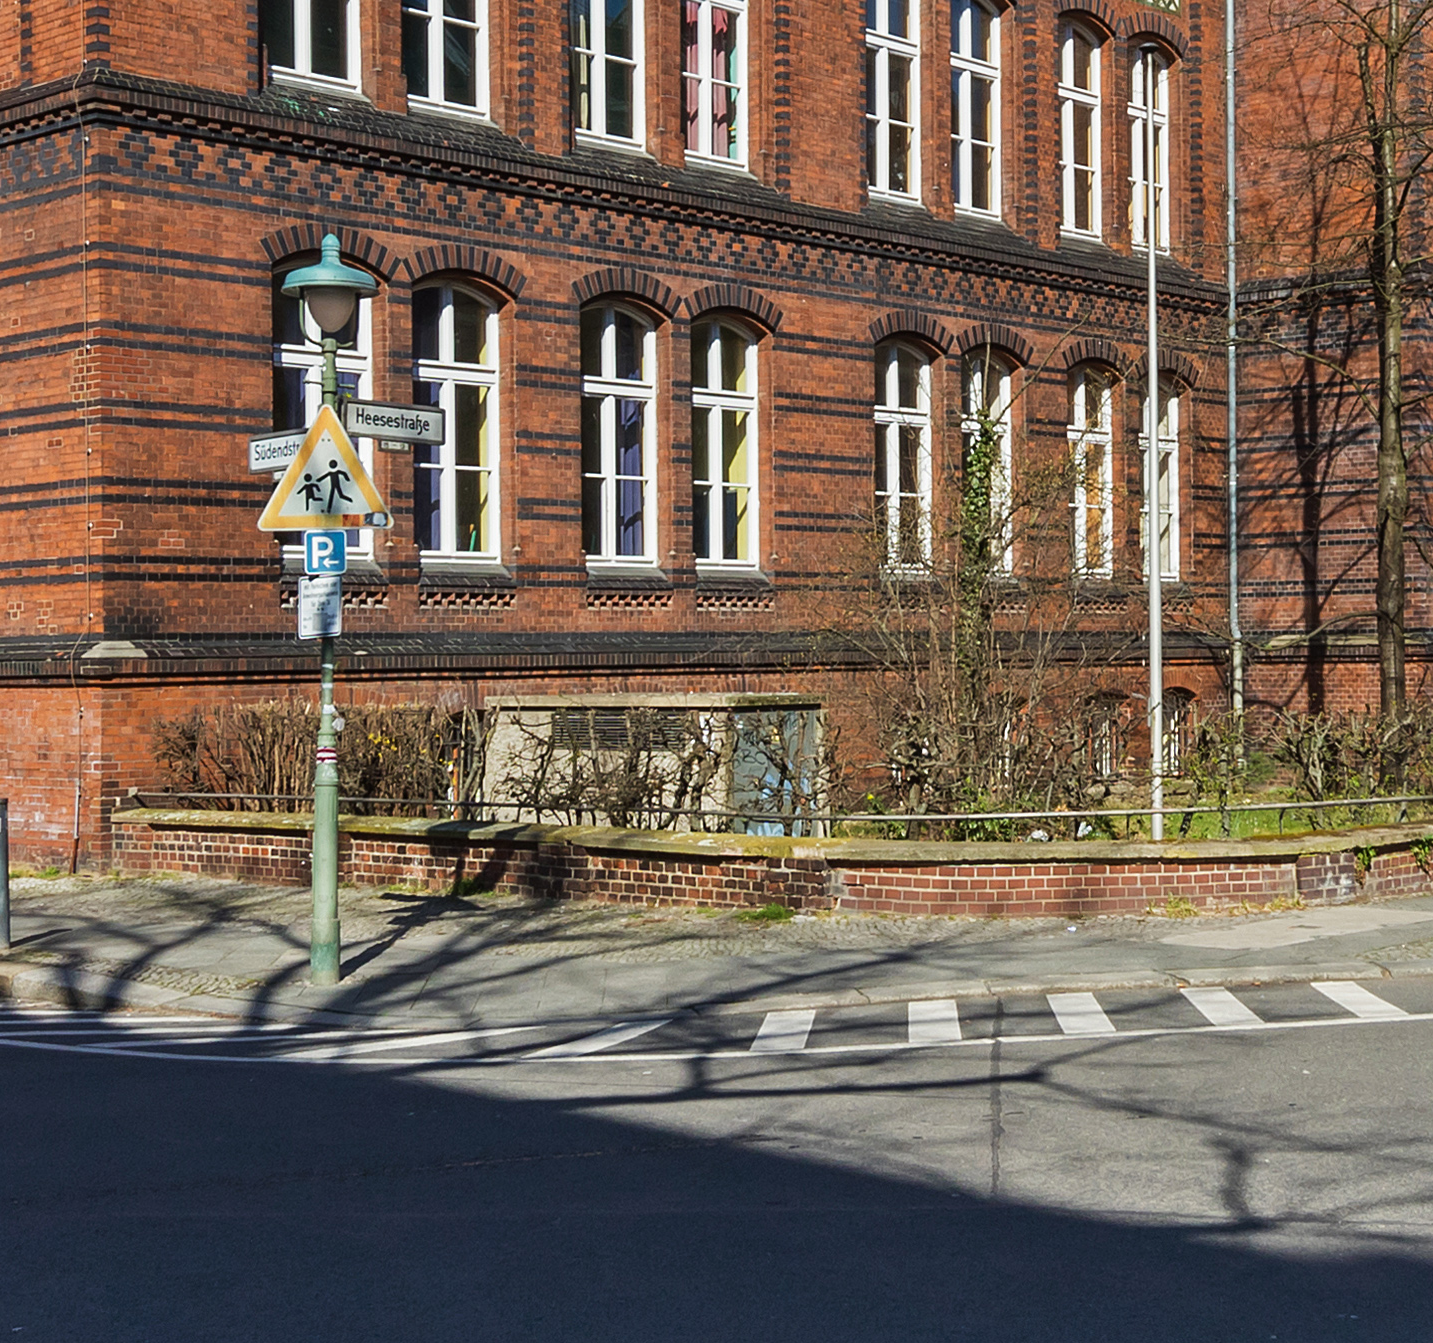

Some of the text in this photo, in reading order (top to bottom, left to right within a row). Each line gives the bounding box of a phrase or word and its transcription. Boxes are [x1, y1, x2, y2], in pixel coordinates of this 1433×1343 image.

[355, 407, 430, 436] Heesestraße
[254, 440, 301, 462] Südendstr
[311, 536, 334, 569] P
